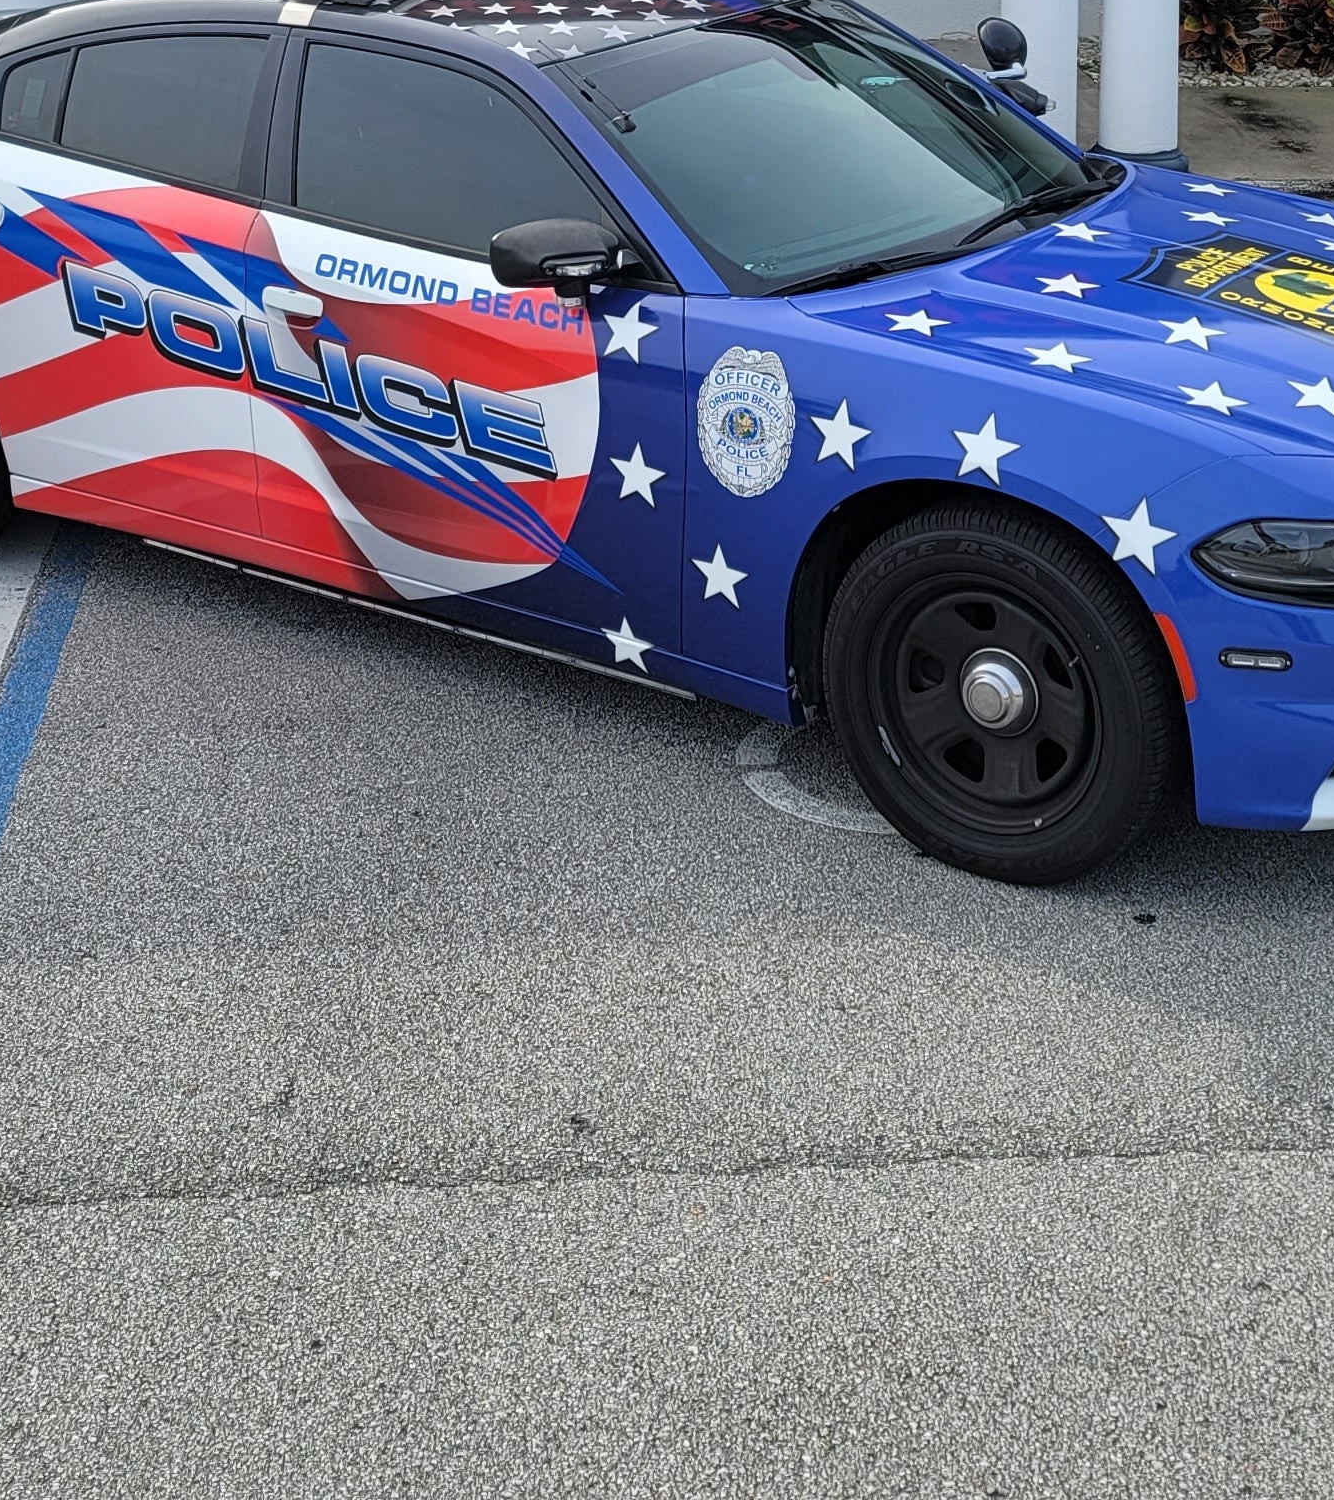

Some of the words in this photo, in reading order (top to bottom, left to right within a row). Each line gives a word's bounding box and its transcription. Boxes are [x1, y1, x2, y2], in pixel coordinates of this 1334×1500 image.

[1175, 247, 1232, 272] POLICE
[1184, 247, 1270, 288] DEPARTMENT
[315, 253, 458, 306] ORMOND
[470, 289, 583, 335] BEACH
[61, 260, 558, 481] POLICE
[714, 371, 781, 396] OFFICER
[708, 391, 749, 410] ORMOND
[751, 395, 783, 423] BEACH
[717, 438, 769, 459] POLICE
[736, 465, 753, 477] FL
